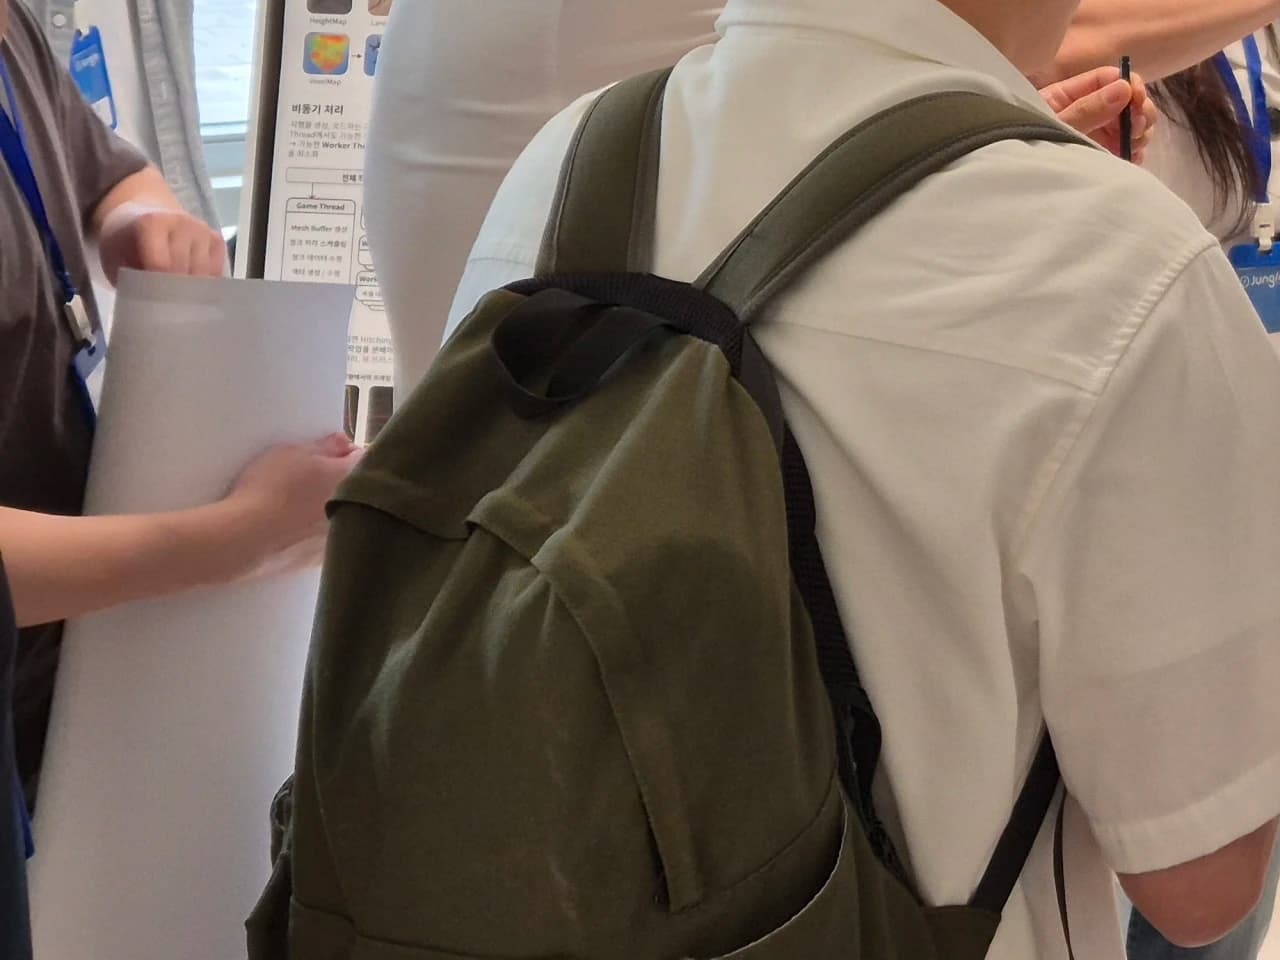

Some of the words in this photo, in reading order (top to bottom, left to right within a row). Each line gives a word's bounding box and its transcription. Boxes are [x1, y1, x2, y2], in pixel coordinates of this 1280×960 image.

[291, 103, 321, 115] 비동기
[323, 104, 344, 116] 처리
[319, 202, 345, 211] Thread
